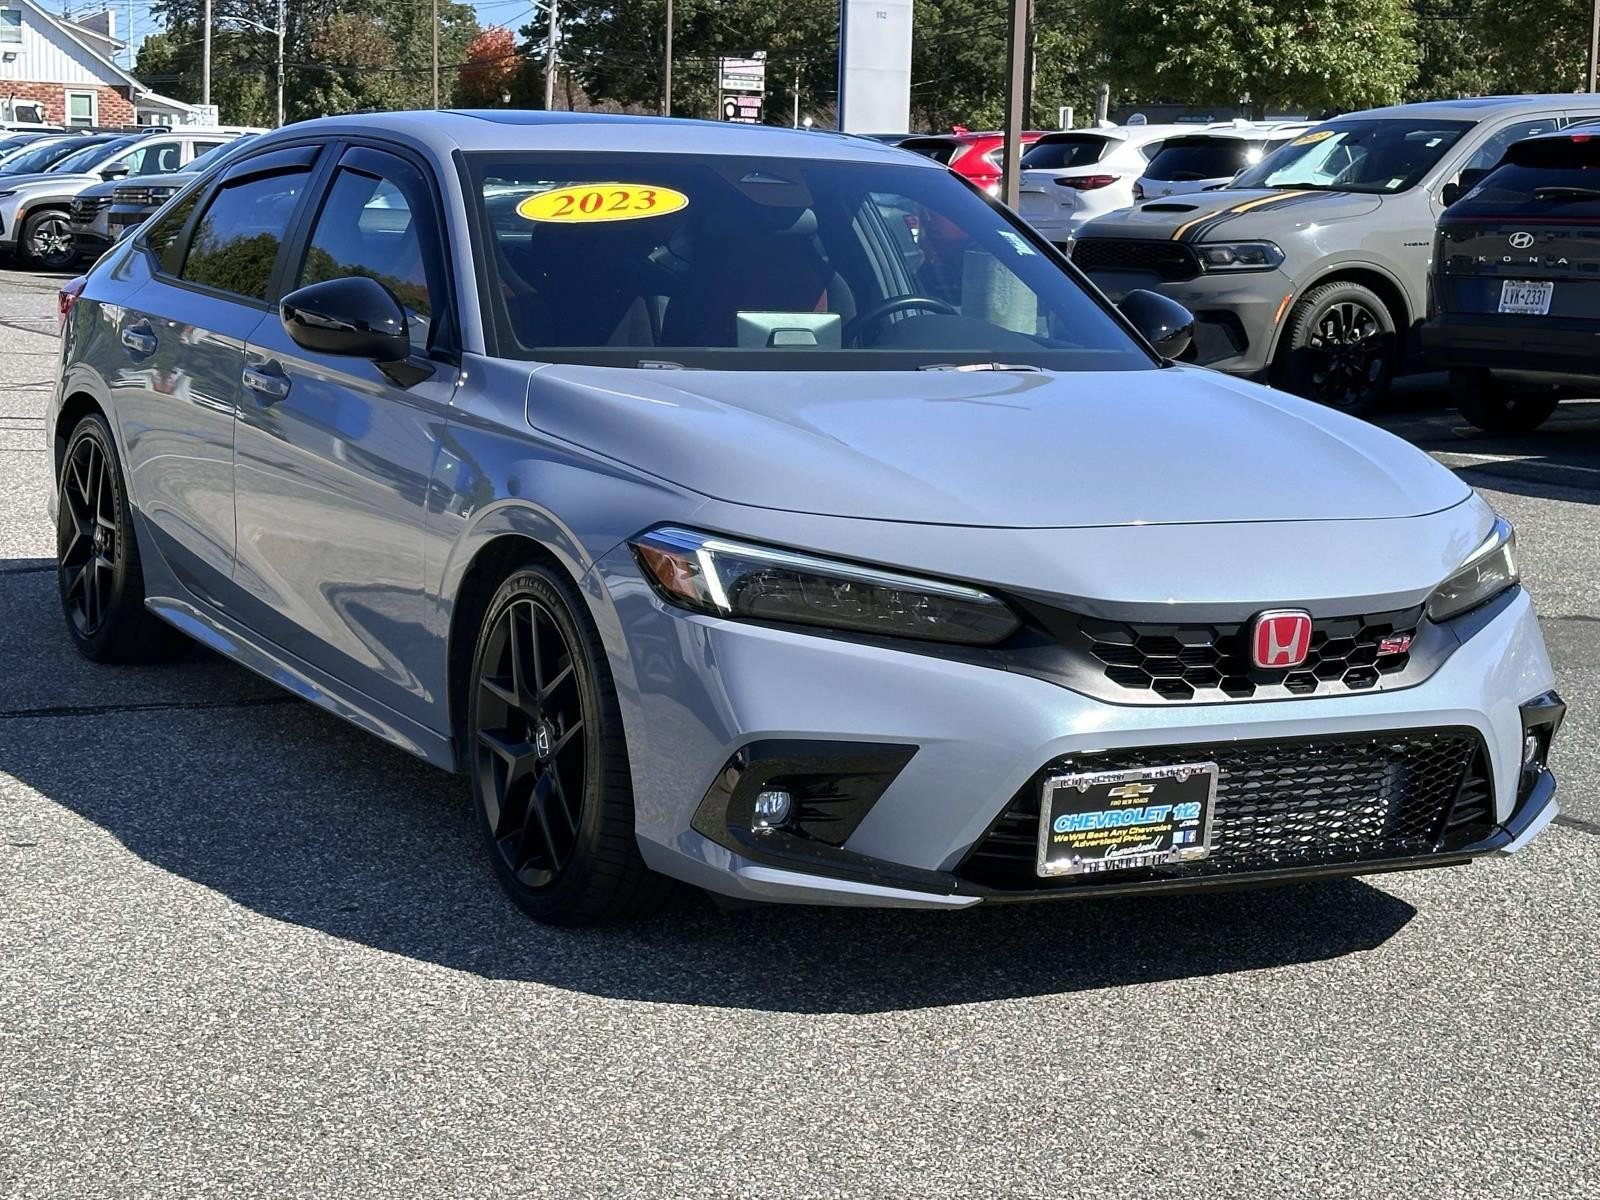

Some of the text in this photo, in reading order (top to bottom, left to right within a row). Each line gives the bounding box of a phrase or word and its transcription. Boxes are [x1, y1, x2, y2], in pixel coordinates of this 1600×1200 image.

[552, 190, 657, 217] 2023
[1478, 255, 1568, 264] KONA
[1053, 801, 1201, 833] CHEVROLET 112
[1087, 830, 1108, 839] Beat
[1109, 827, 1128, 836] Any
[1128, 824, 1172, 835] Chevrolet
[1072, 837, 1121, 848] Advertised
